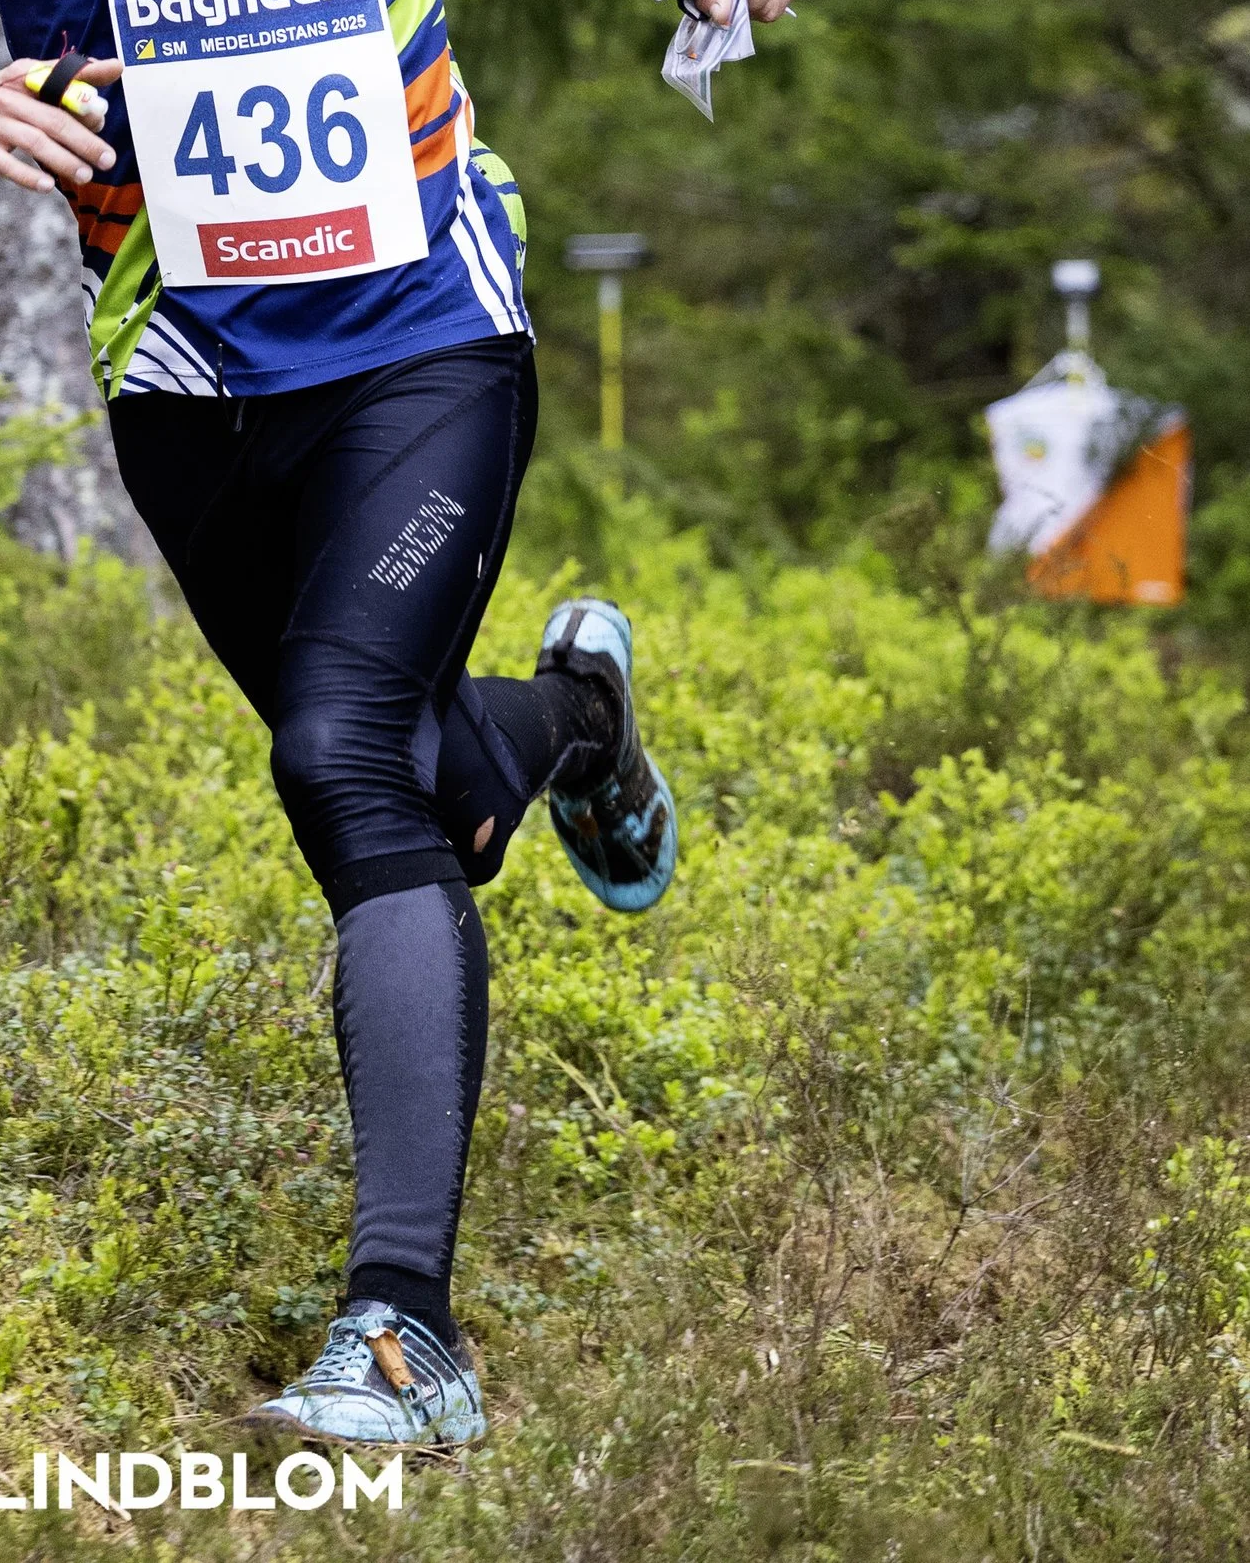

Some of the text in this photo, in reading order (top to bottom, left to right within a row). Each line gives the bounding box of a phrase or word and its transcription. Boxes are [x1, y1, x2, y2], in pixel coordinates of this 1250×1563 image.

[161, 13, 367, 56] SM MEDELDISTANS 2025
[173, 73, 368, 196] 436
[217, 225, 355, 263] Scandic
